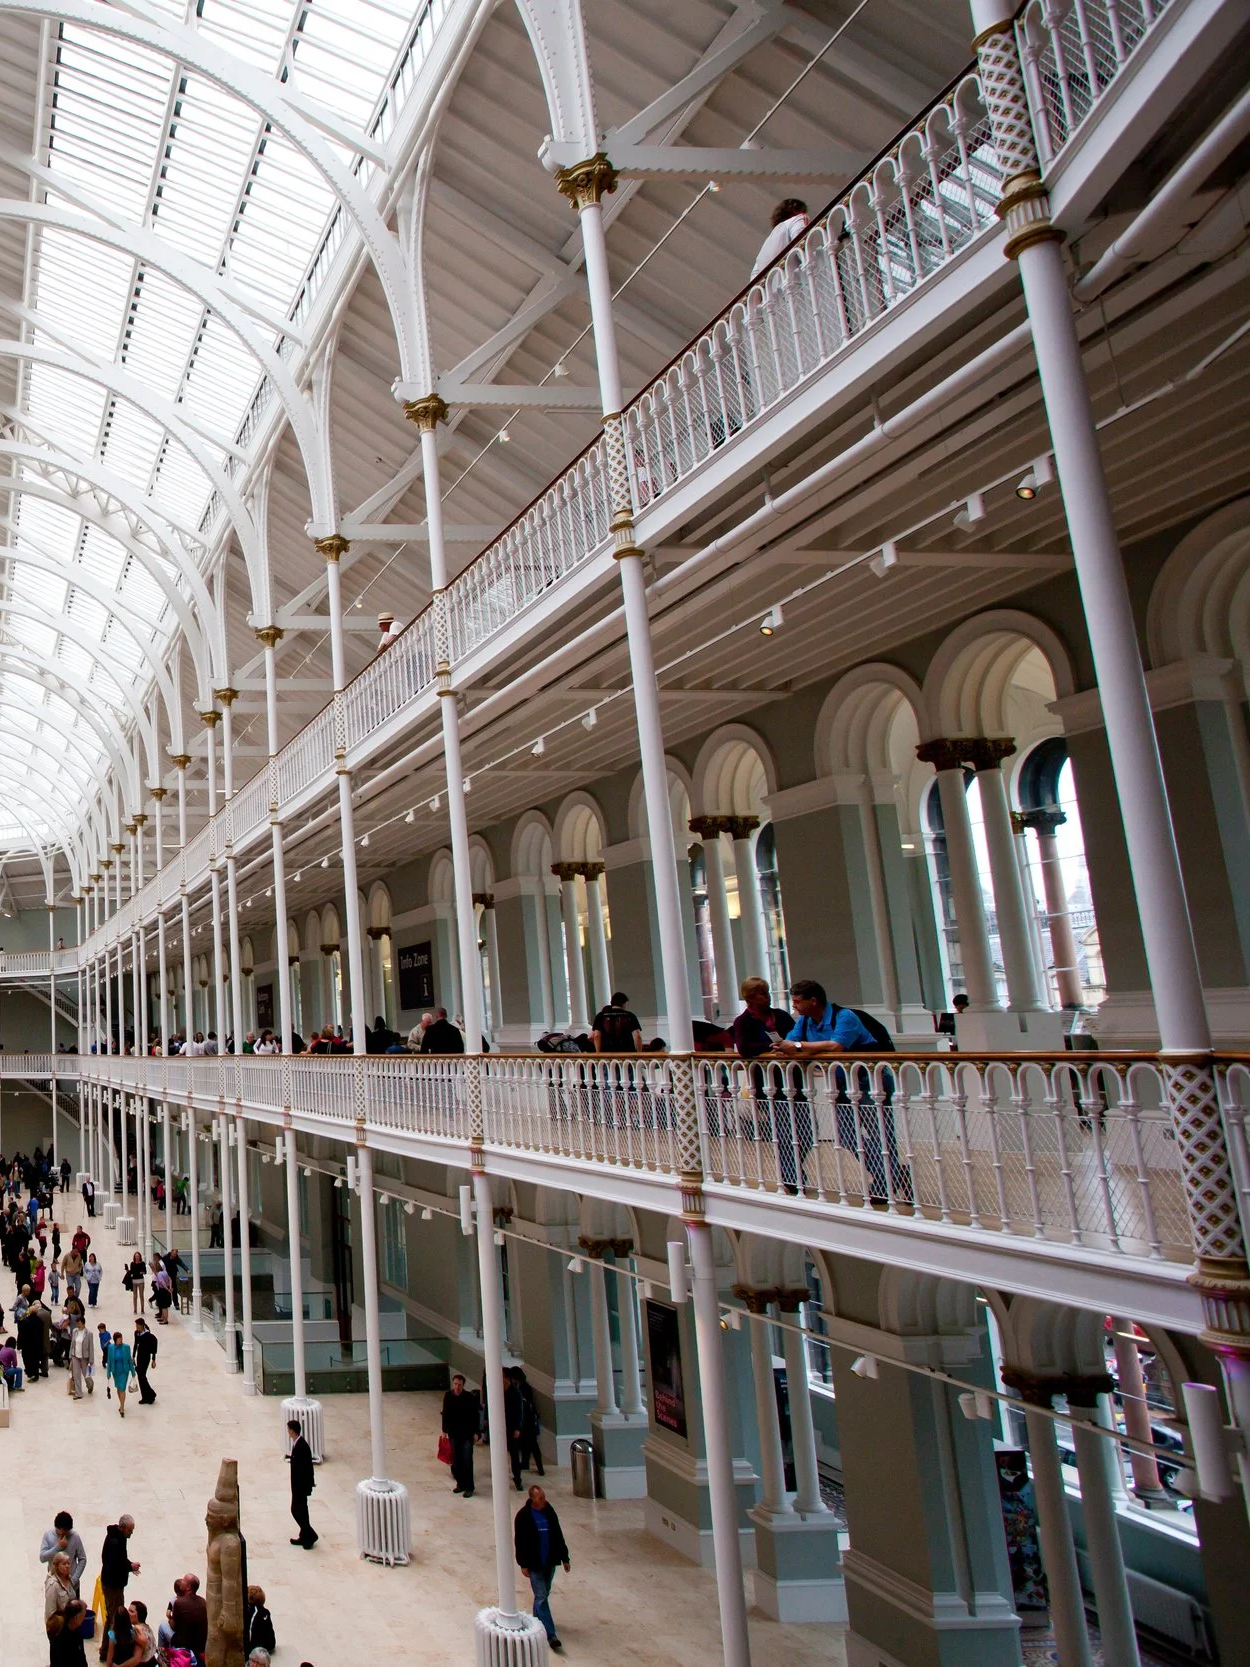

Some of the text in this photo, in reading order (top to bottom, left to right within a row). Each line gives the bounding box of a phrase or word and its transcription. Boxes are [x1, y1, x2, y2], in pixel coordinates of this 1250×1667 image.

[400, 952, 428, 970] Info Zone
[654, 1389, 677, 1408] Behind
